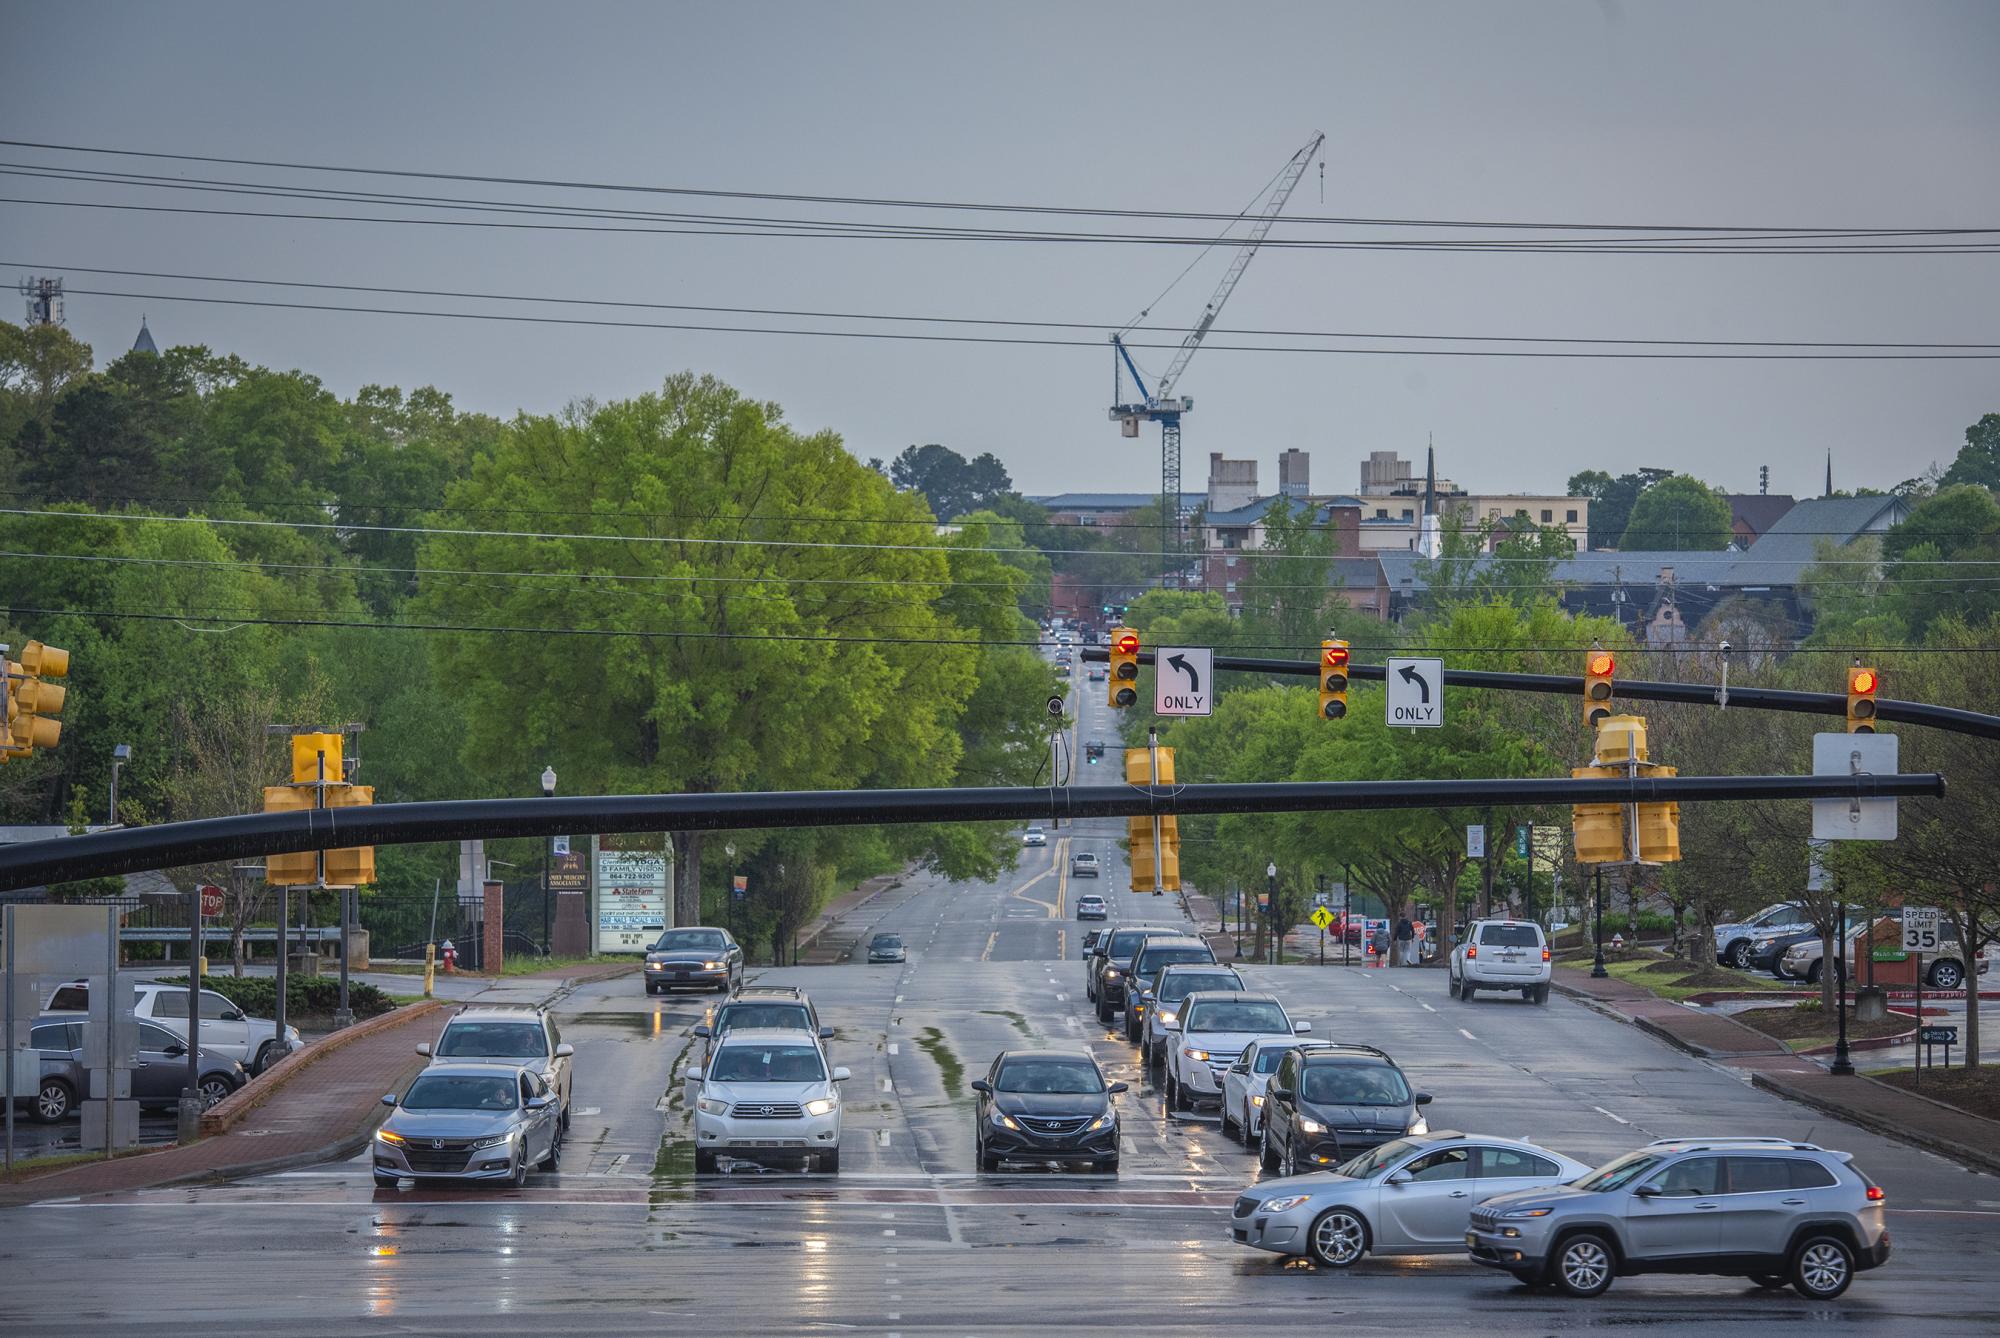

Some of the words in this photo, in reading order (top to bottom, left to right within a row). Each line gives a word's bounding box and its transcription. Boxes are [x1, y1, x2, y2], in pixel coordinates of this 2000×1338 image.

[1164, 696, 1203, 709] ONLY
[1395, 707, 1434, 720] ONLY
[202, 894, 224, 907] TOP
[1905, 911, 1937, 919] SPEED
[1908, 920, 1933, 928] LIMIT
[1906, 930, 1936, 947] 35
